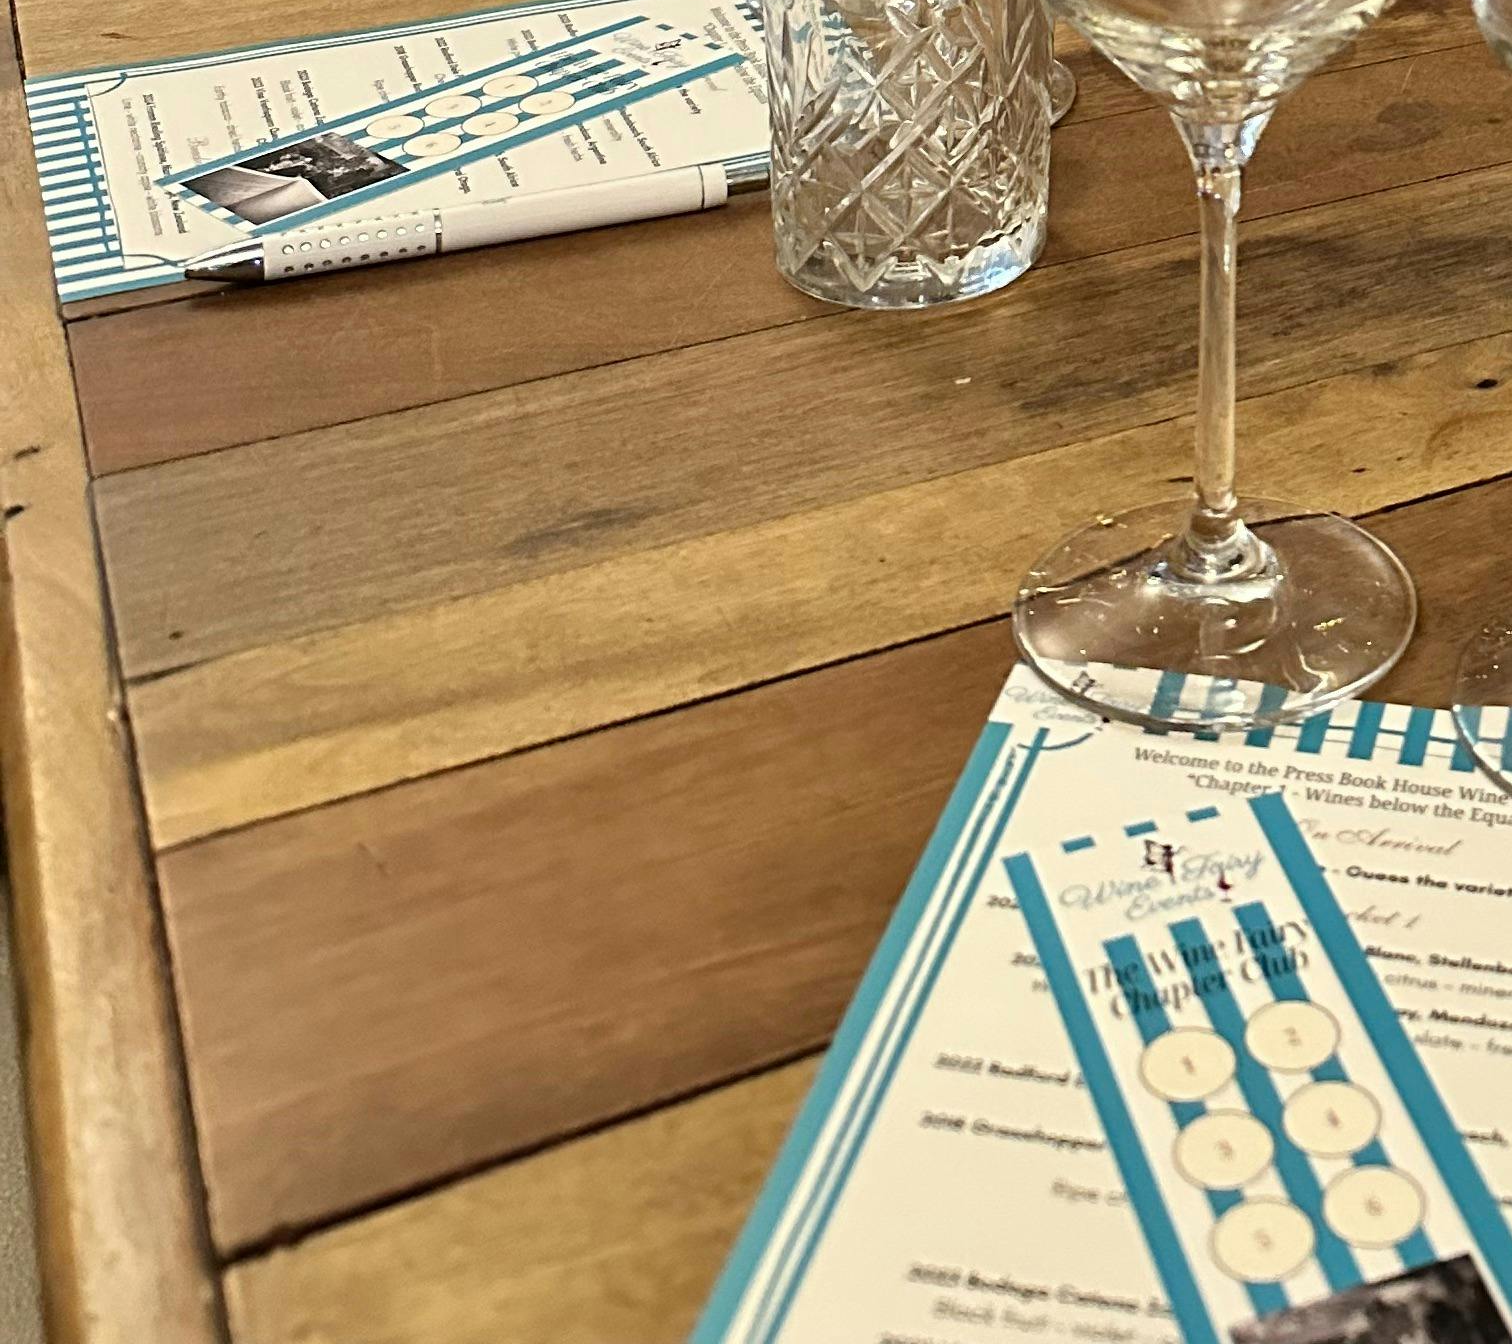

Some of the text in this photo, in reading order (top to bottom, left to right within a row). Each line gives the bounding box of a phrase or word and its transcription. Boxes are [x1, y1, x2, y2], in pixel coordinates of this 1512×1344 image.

[1134, 746, 1220, 772] Welcome
[1224, 758, 1244, 775] to
[1247, 761, 1280, 779] the
[1284, 765, 1335, 787] Press
[1338, 769, 1388, 792] Book
[1391, 776, 1454, 800] House
[1458, 785, 1510, 807] Wine
[1304, 786, 1367, 809] Wines
[1367, 792, 1431, 818] below
[1432, 800, 1466, 822] the
[1337, 824, 1463, 858] Arrival
[1059, 875, 1162, 910] Wine
[1345, 864, 1410, 886] Guess
[1415, 870, 1448, 890] the
[1124, 886, 1217, 922] Events
[1085, 918, 1309, 995] The Wine Fairy
[1109, 946, 1310, 1020] Chapter Club
